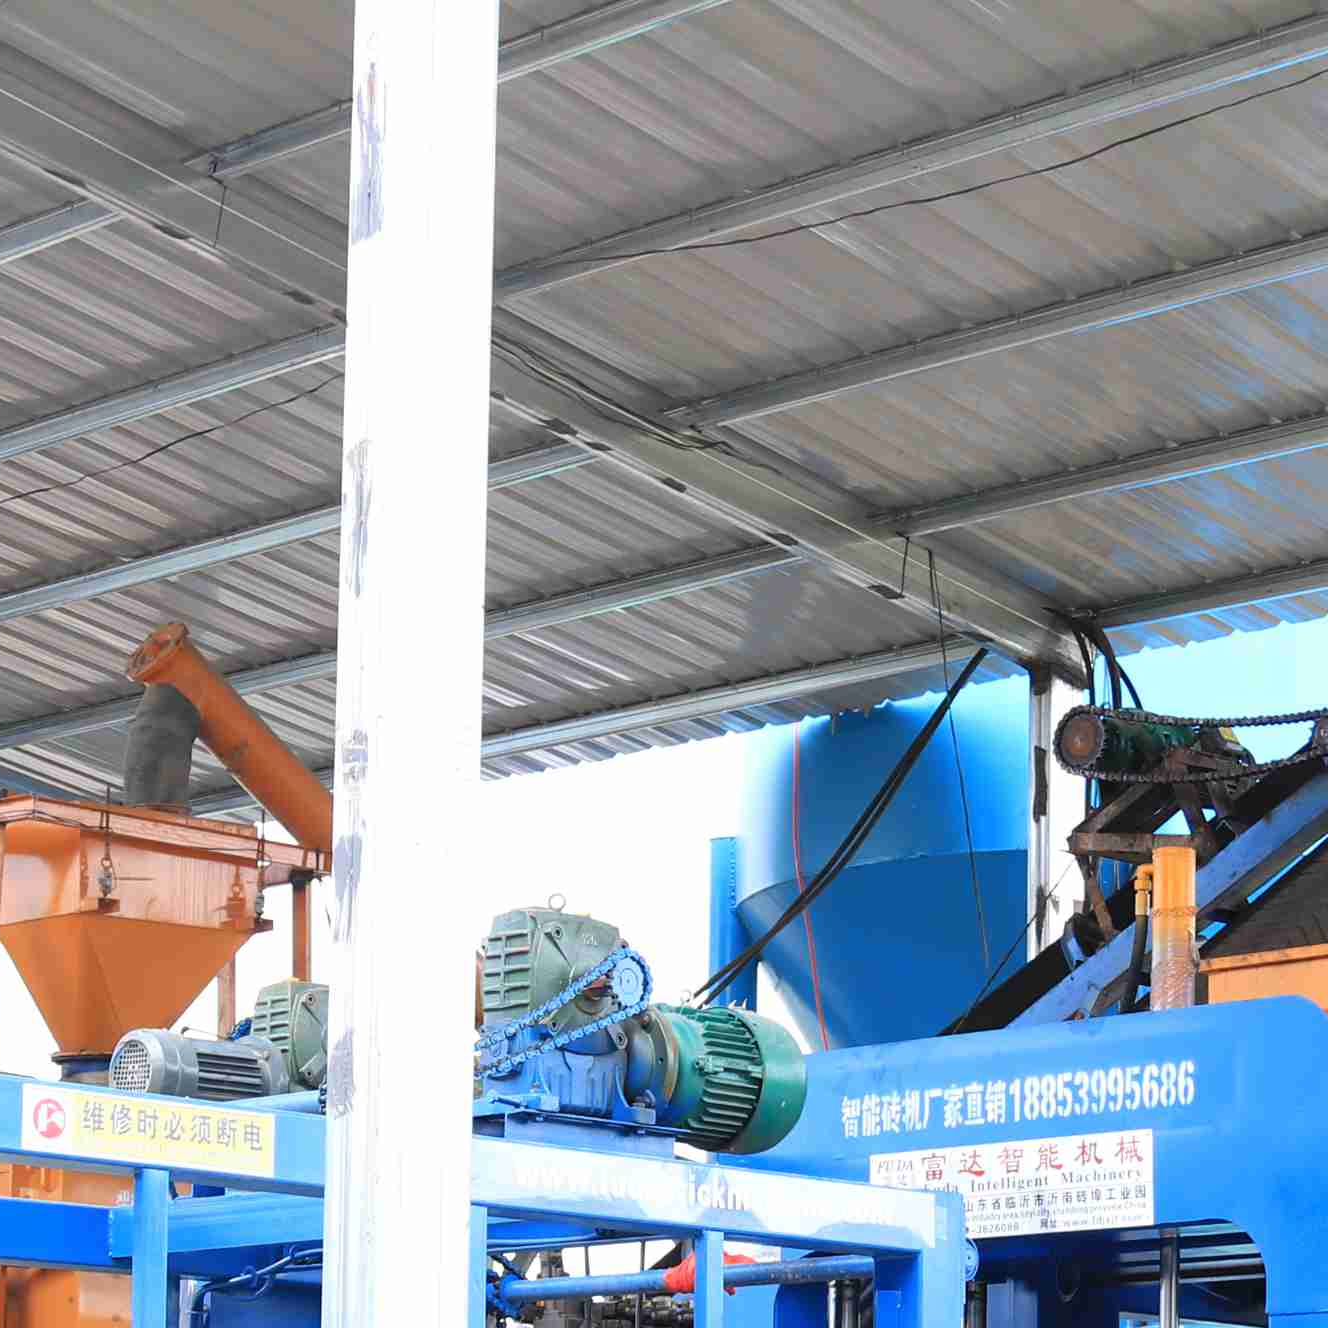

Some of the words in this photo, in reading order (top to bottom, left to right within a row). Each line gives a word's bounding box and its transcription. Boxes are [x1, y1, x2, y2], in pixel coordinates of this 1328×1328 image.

[841, 1060, 1196, 1138] 智能砖机厂家直销18853995686
[82, 1100, 264, 1152] 维修时必须断电
[921, 1135, 1145, 1181] 富达智能机械
[970, 1174, 1050, 1194] Intelligent
[1061, 1168, 1144, 1185] Machinery
